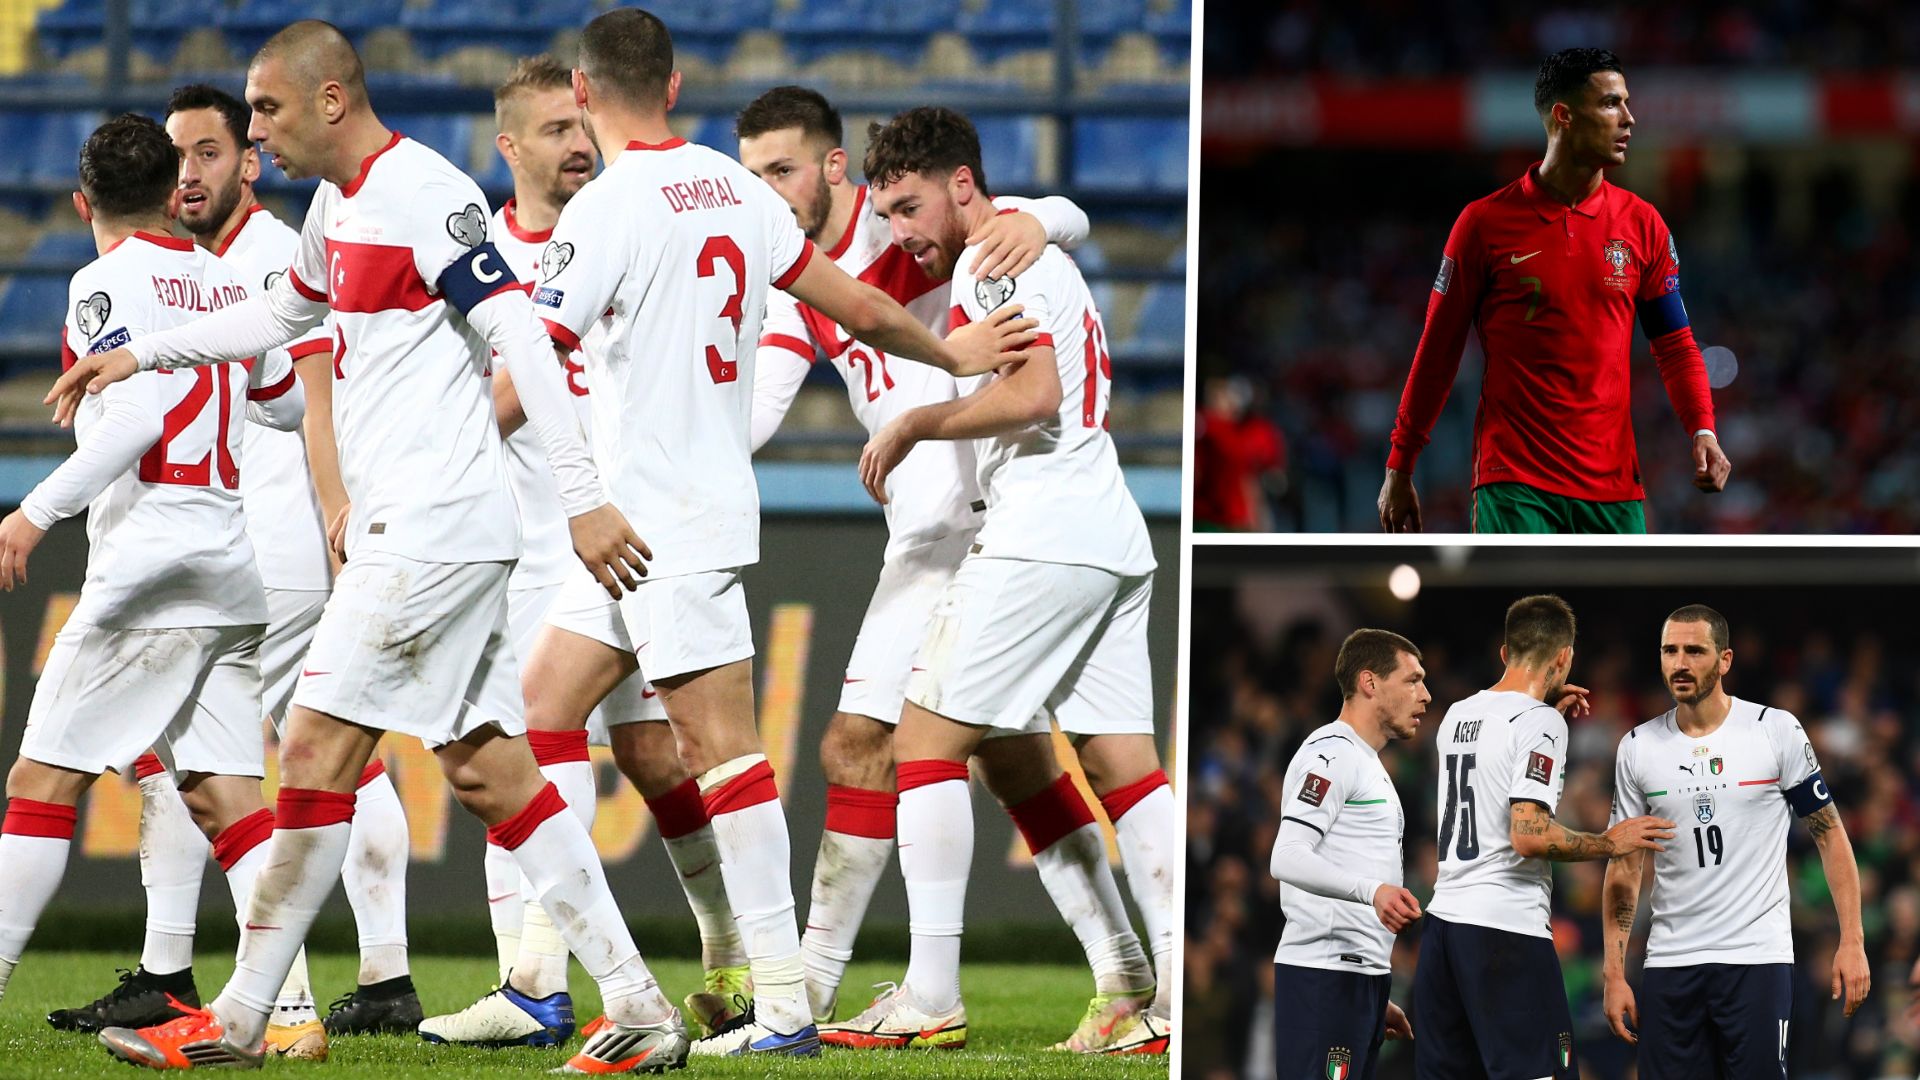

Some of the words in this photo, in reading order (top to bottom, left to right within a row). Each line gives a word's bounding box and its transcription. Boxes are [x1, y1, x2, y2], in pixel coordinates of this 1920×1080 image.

[661, 175, 742, 214] DEMİRAL
[471, 252, 503, 284] C
[151, 273, 248, 313] ABDÜLADİ
[697, 235, 746, 385] 3
[1519, 277, 1541, 321] 7
[1437, 753, 1480, 862] 15
[1812, 779, 1829, 800] C
[1693, 824, 1724, 868] 19
